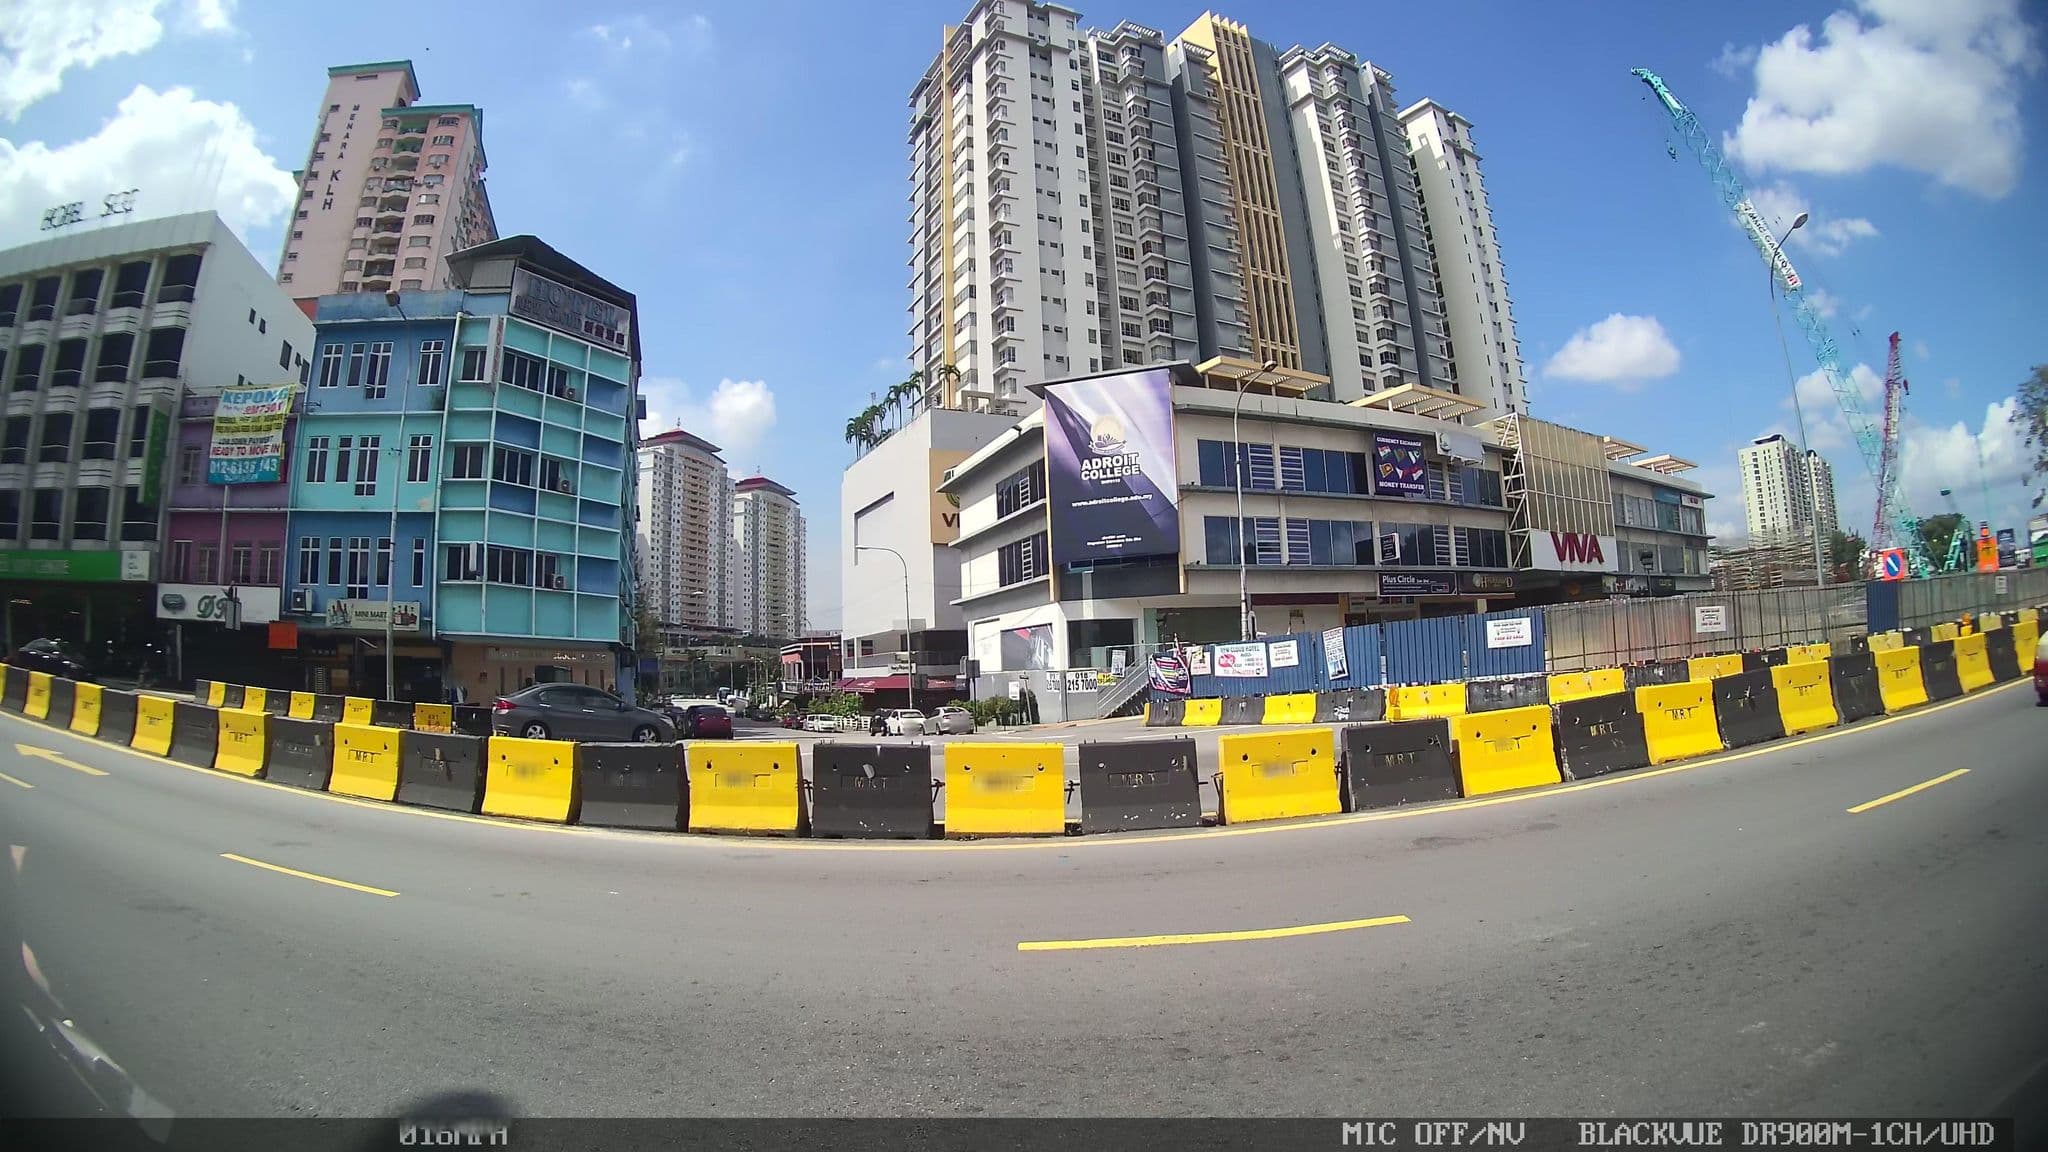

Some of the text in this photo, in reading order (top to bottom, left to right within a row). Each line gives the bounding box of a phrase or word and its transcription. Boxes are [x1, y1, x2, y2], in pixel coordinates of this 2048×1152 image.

[322, 104, 360, 210] MENARA KLH
[527, 276, 618, 331] HOTEL
[211, 443, 280, 456] READY TO MOVE IN
[1081, 453, 1139, 471] ADROIT
[1081, 465, 1140, 480] COLLEGE
[1400, 482, 1425, 490] TRANSFER
[1551, 532, 1604, 564] VIVA
[1382, 575, 1397, 584] Plus
[1397, 575, 1415, 584] Circle
[1067, 680, 1080, 691] 215
[1080, 679, 1097, 690] 7000
[1672, 708, 1692, 720] MRT
[1590, 722, 1615, 736] MRT
[354, 750, 375, 763] MRT
[1384, 751, 1415, 767] MRT
[1121, 772, 1155, 785] MRT
